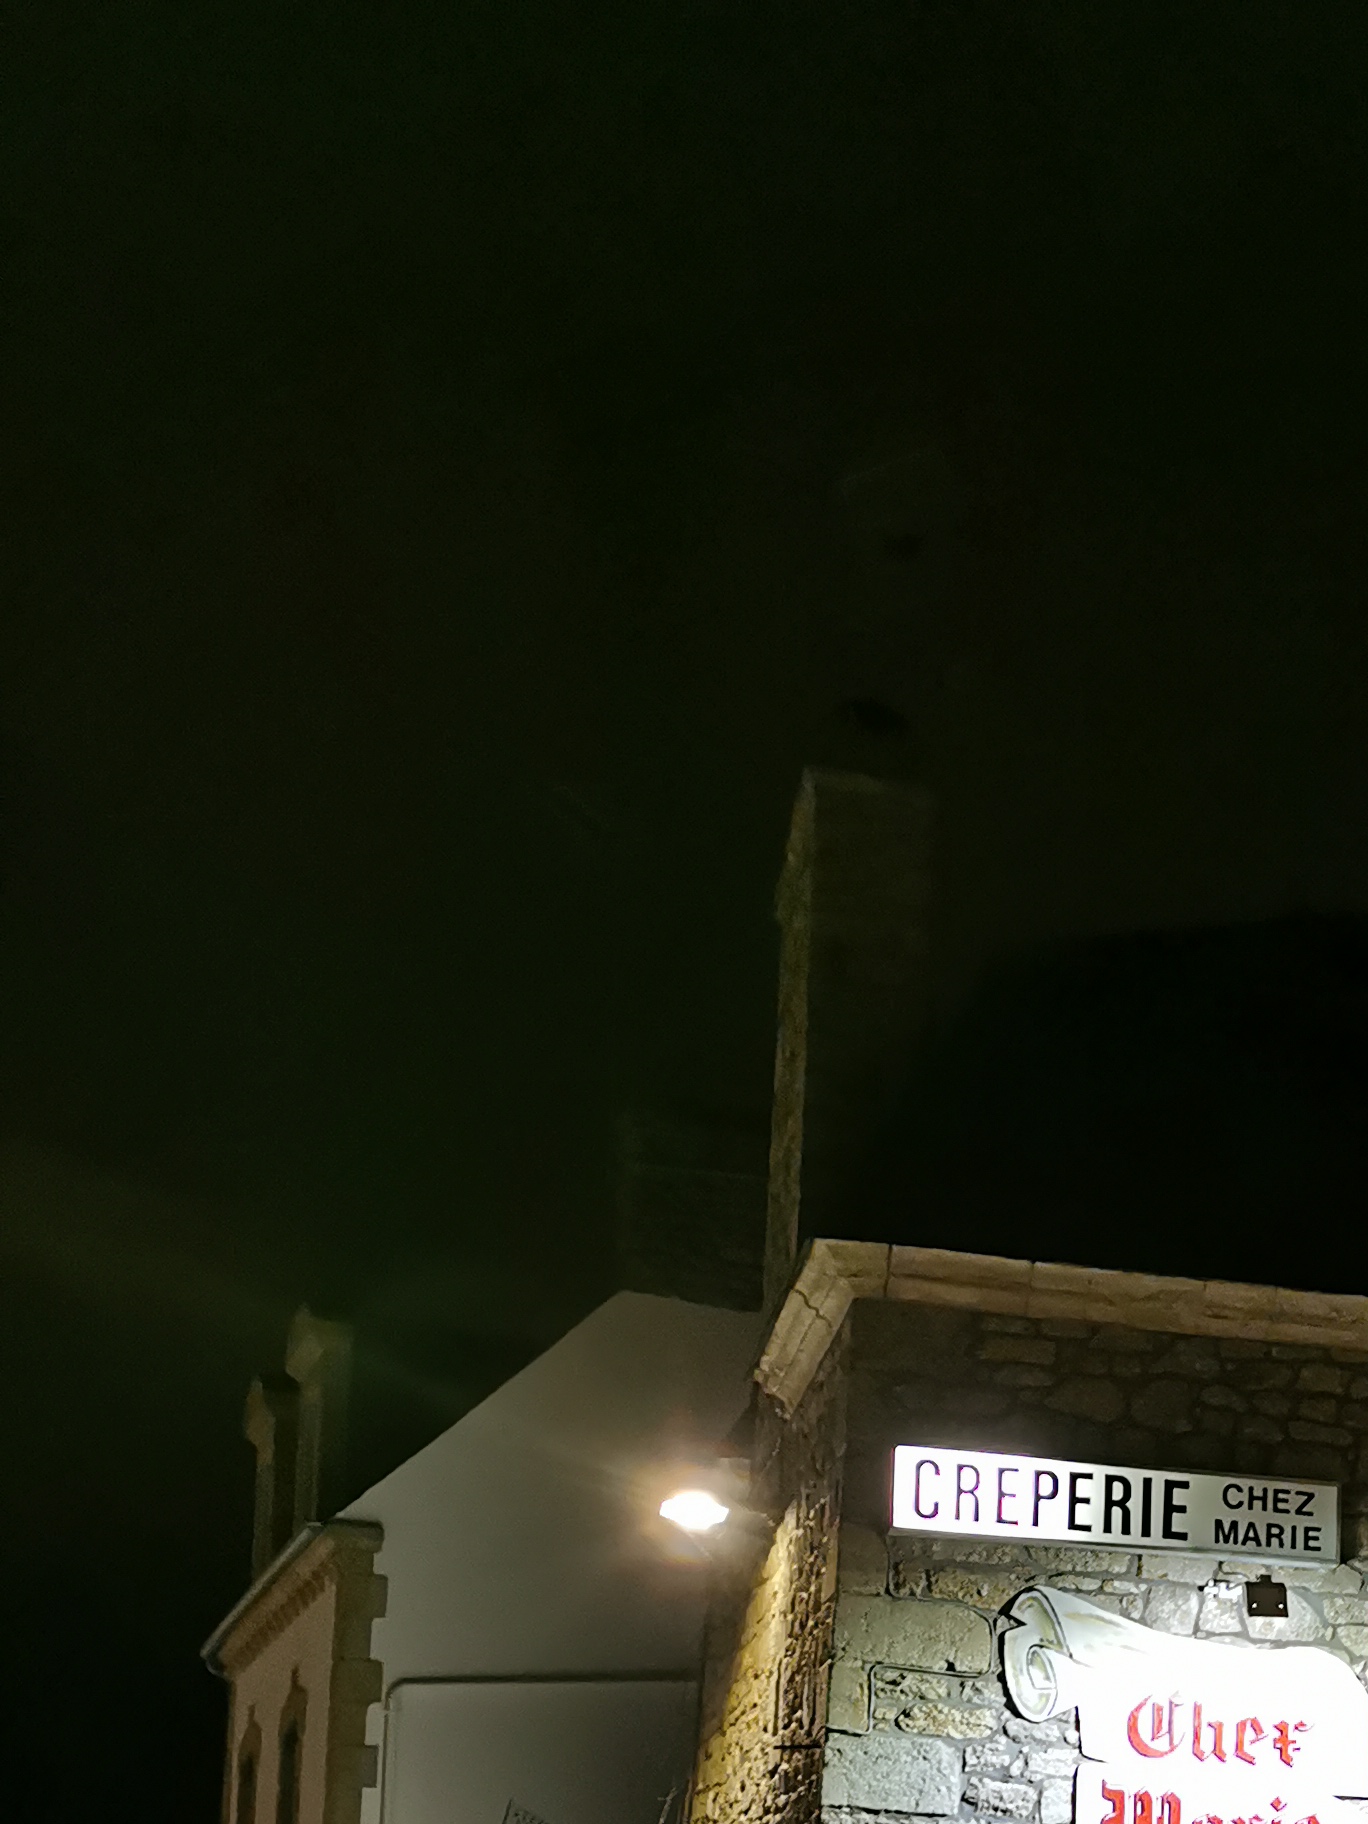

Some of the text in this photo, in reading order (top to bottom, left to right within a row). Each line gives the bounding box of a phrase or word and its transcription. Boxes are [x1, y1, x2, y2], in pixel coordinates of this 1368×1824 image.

[914, 1459, 1190, 1541] CREPERIE
[1221, 1483, 1316, 1517] CHEZ
[1214, 1519, 1323, 1552] MARIE
[1127, 1691, 1315, 1768] Chez
